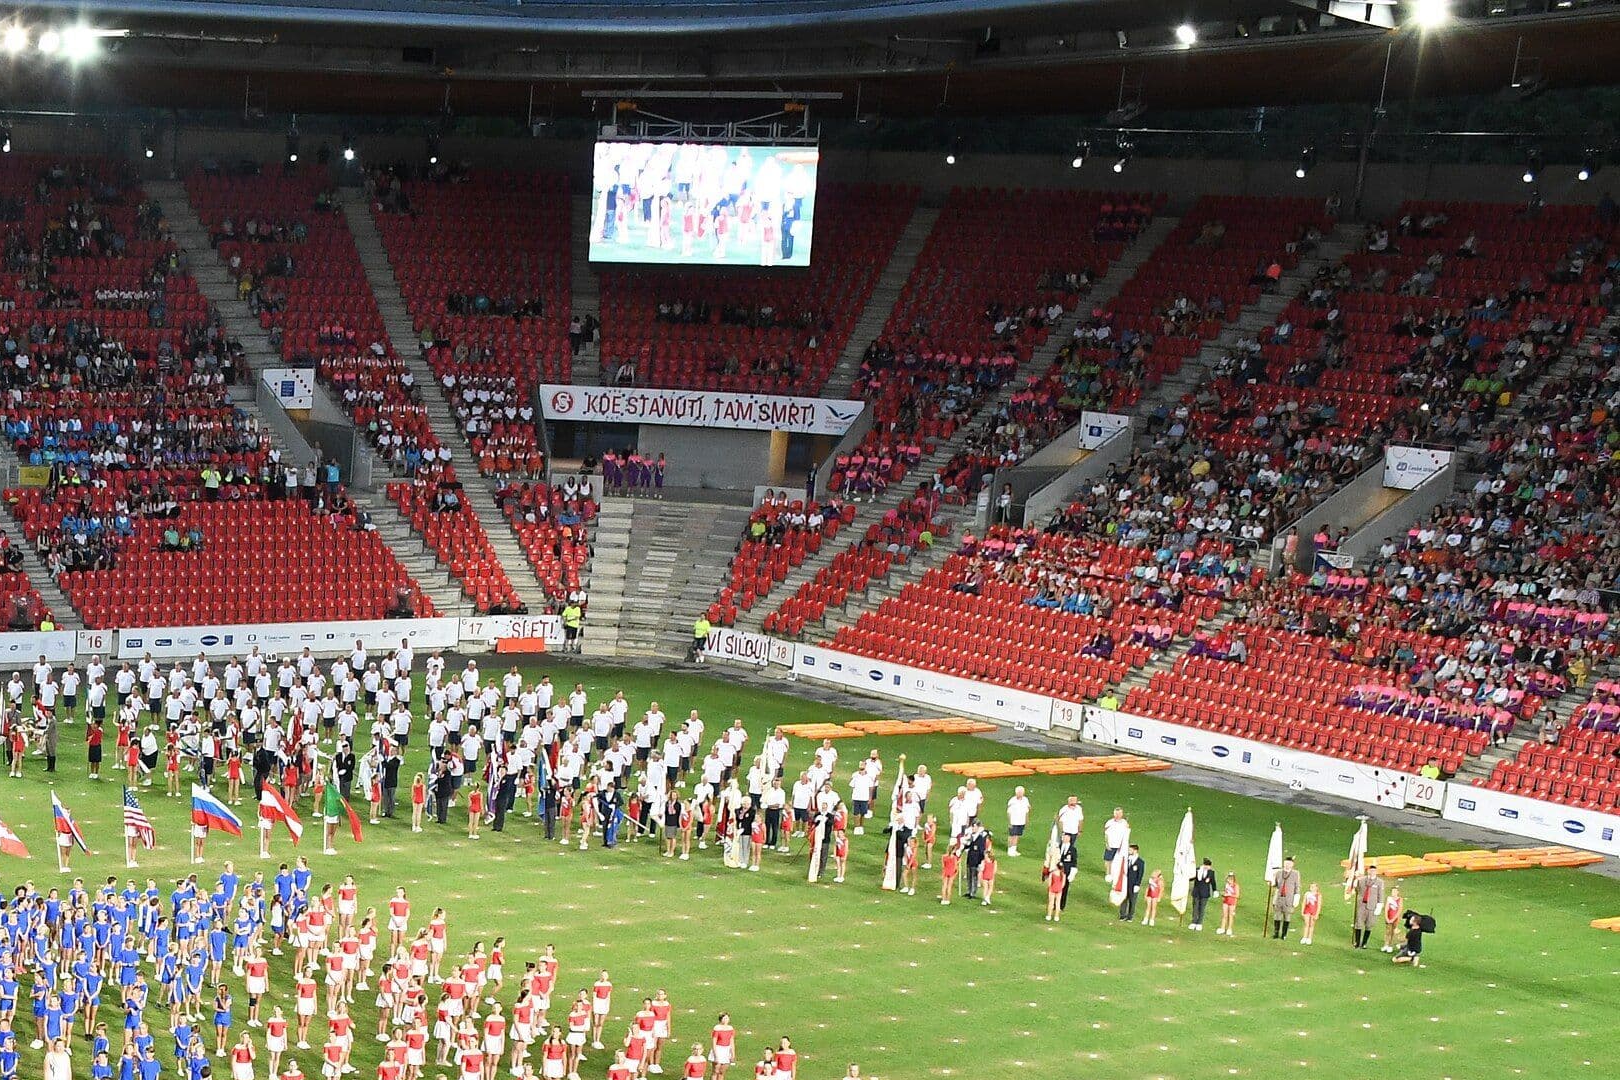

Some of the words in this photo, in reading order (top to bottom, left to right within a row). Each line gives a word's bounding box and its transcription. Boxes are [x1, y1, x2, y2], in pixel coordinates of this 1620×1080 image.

[586, 394, 621, 415] KDE
[714, 398, 753, 421] TAM
[759, 401, 815, 426] SMRT!
[469, 622, 483, 635] 17
[87, 635, 102, 649] 16
[776, 645, 787, 659] 18
[1061, 707, 1073, 721] 19
[1415, 784, 1434, 801] 20
